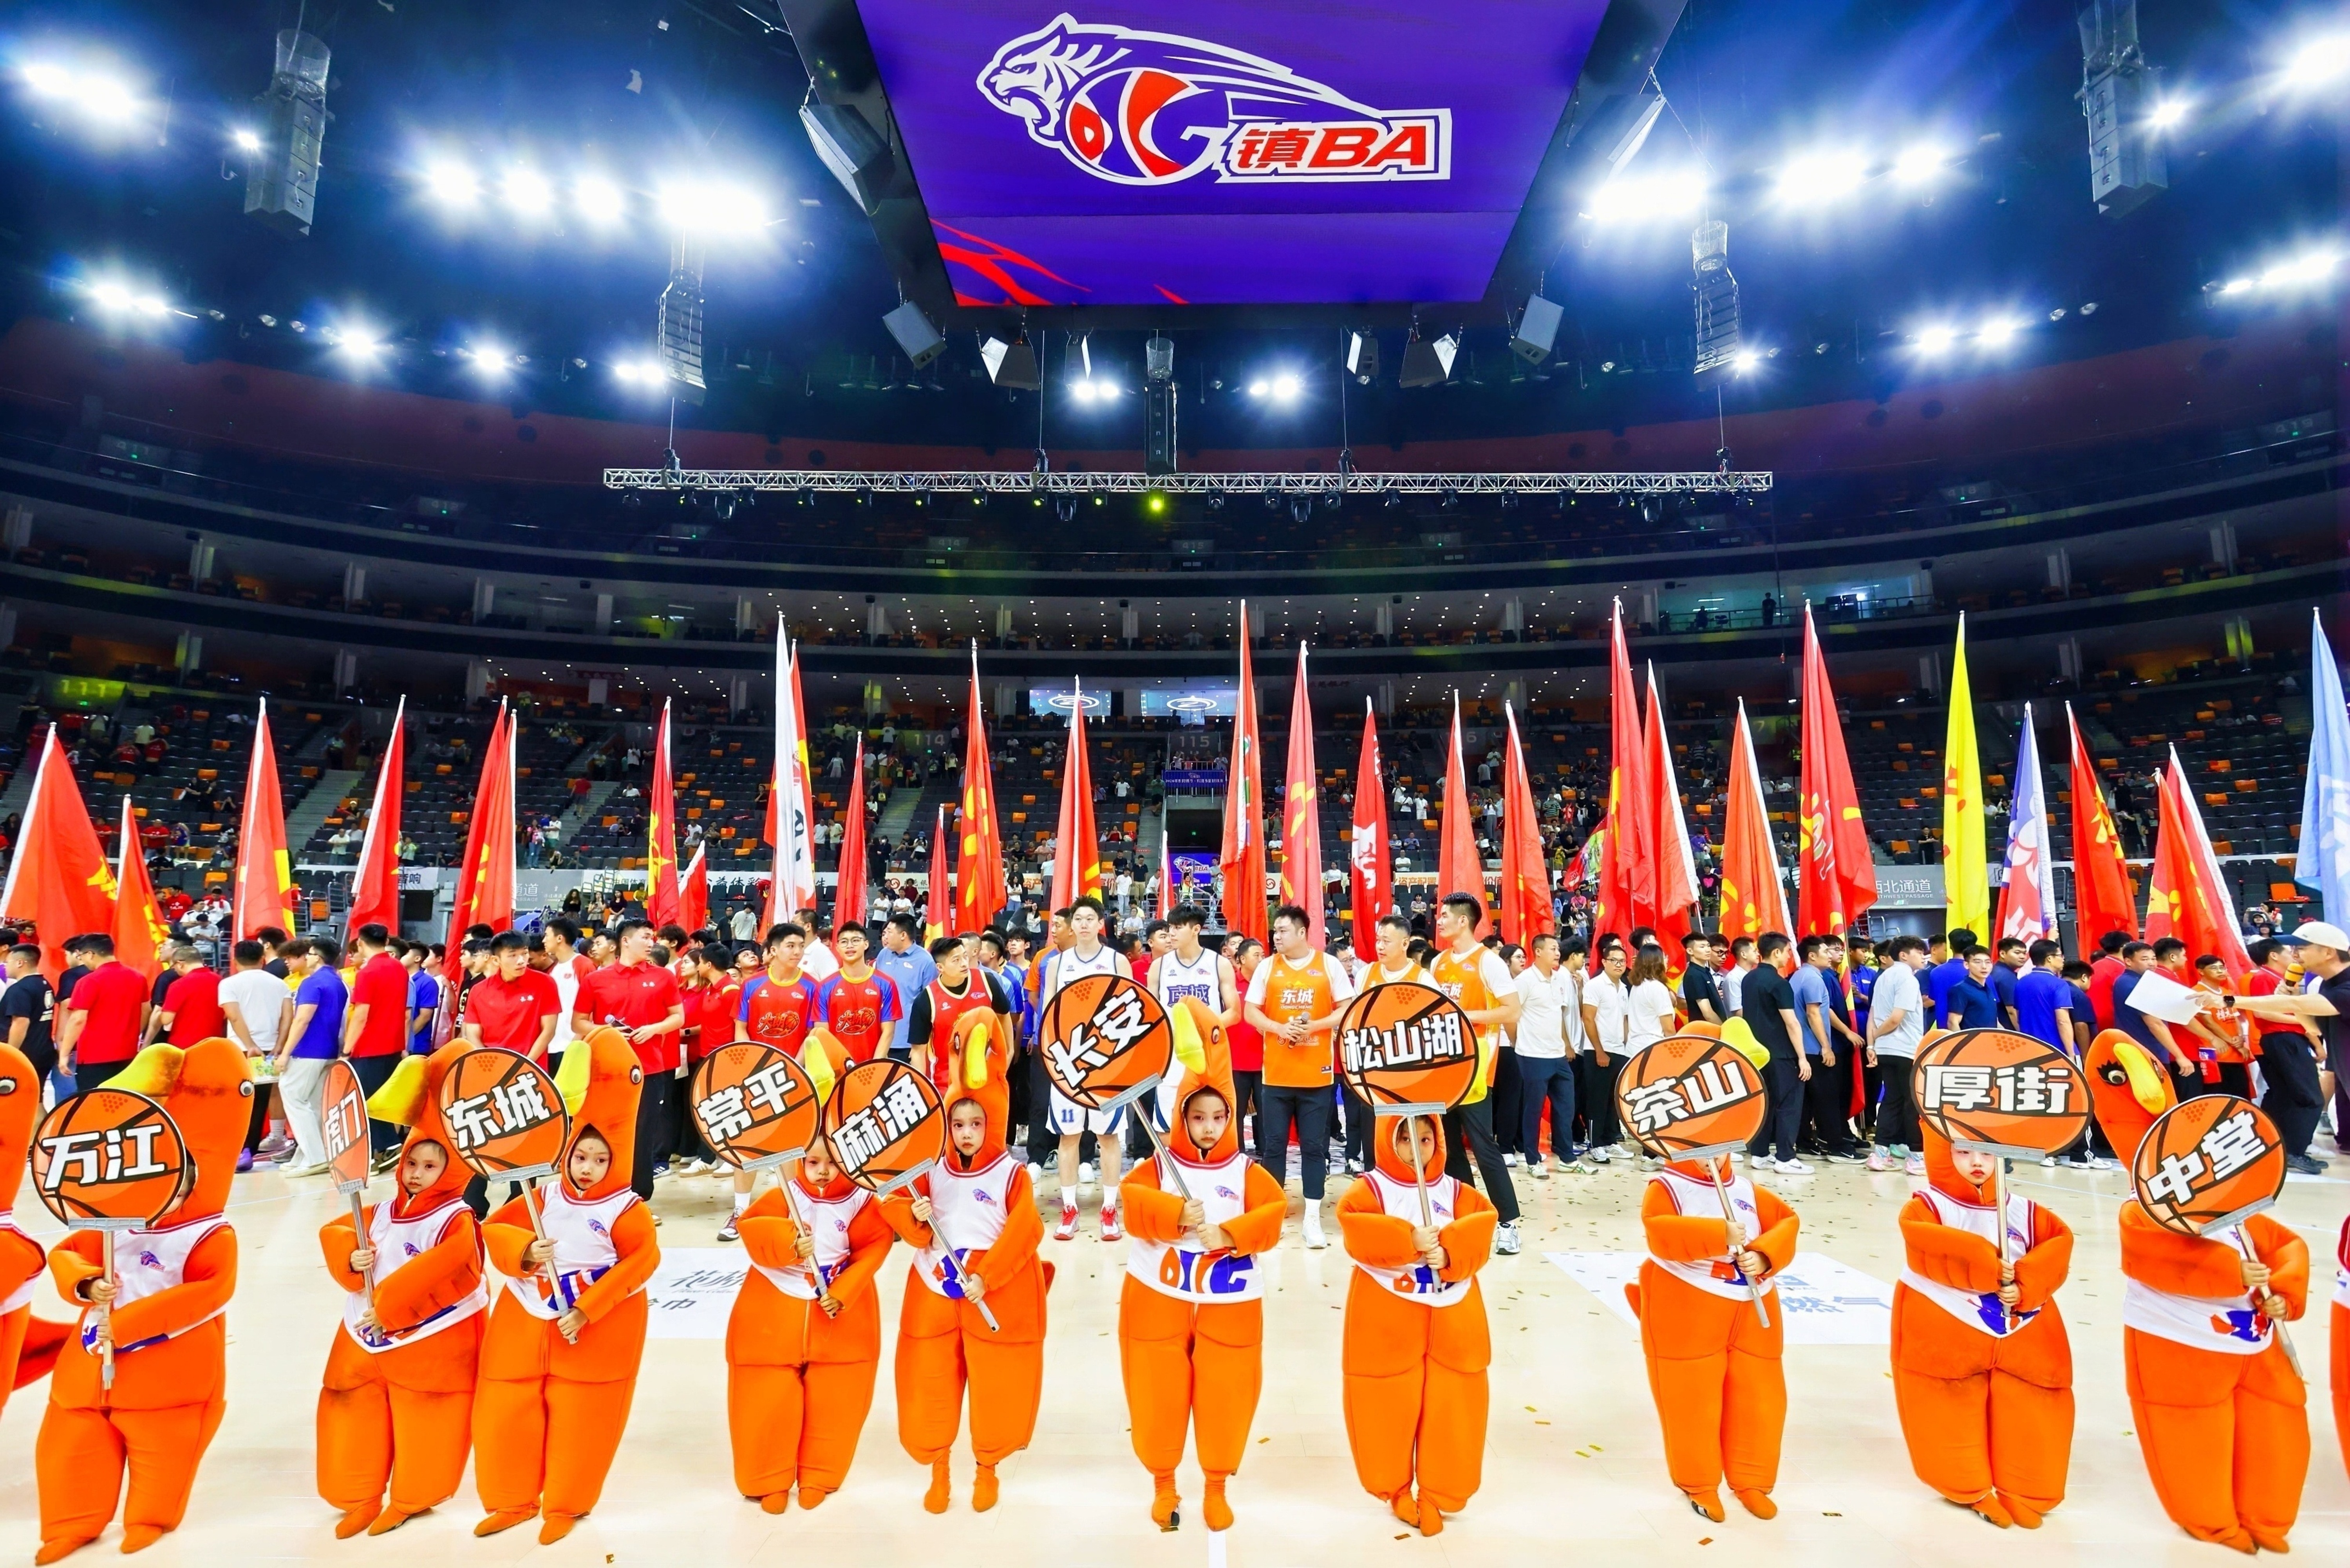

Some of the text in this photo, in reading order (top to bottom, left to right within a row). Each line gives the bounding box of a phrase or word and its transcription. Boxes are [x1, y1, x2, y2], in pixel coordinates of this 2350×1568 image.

[1236, 125, 1427, 169] 镇BA
[61, 680, 106, 697] 111
[915, 734, 944, 746] 114
[1180, 736, 1209, 747] 115
[1281, 989, 1315, 1004] 东城
[1048, 987, 1152, 1088] 长安
[1344, 1012, 1463, 1072] 松山湖
[446, 1073, 551, 1148] 东城
[697, 1060, 795, 1143] 常平
[1061, 1109, 1075, 1123] 11
[1625, 1060, 1748, 1134] 茶山
[1924, 1065, 2070, 1114] 厚街
[326, 1090, 362, 1159] 虎门
[832, 1073, 929, 1173] 麻涌
[42, 1124, 166, 1190] 万江
[2147, 1111, 2267, 1205] 中堂
[647, 1298, 697, 1310] 巾
